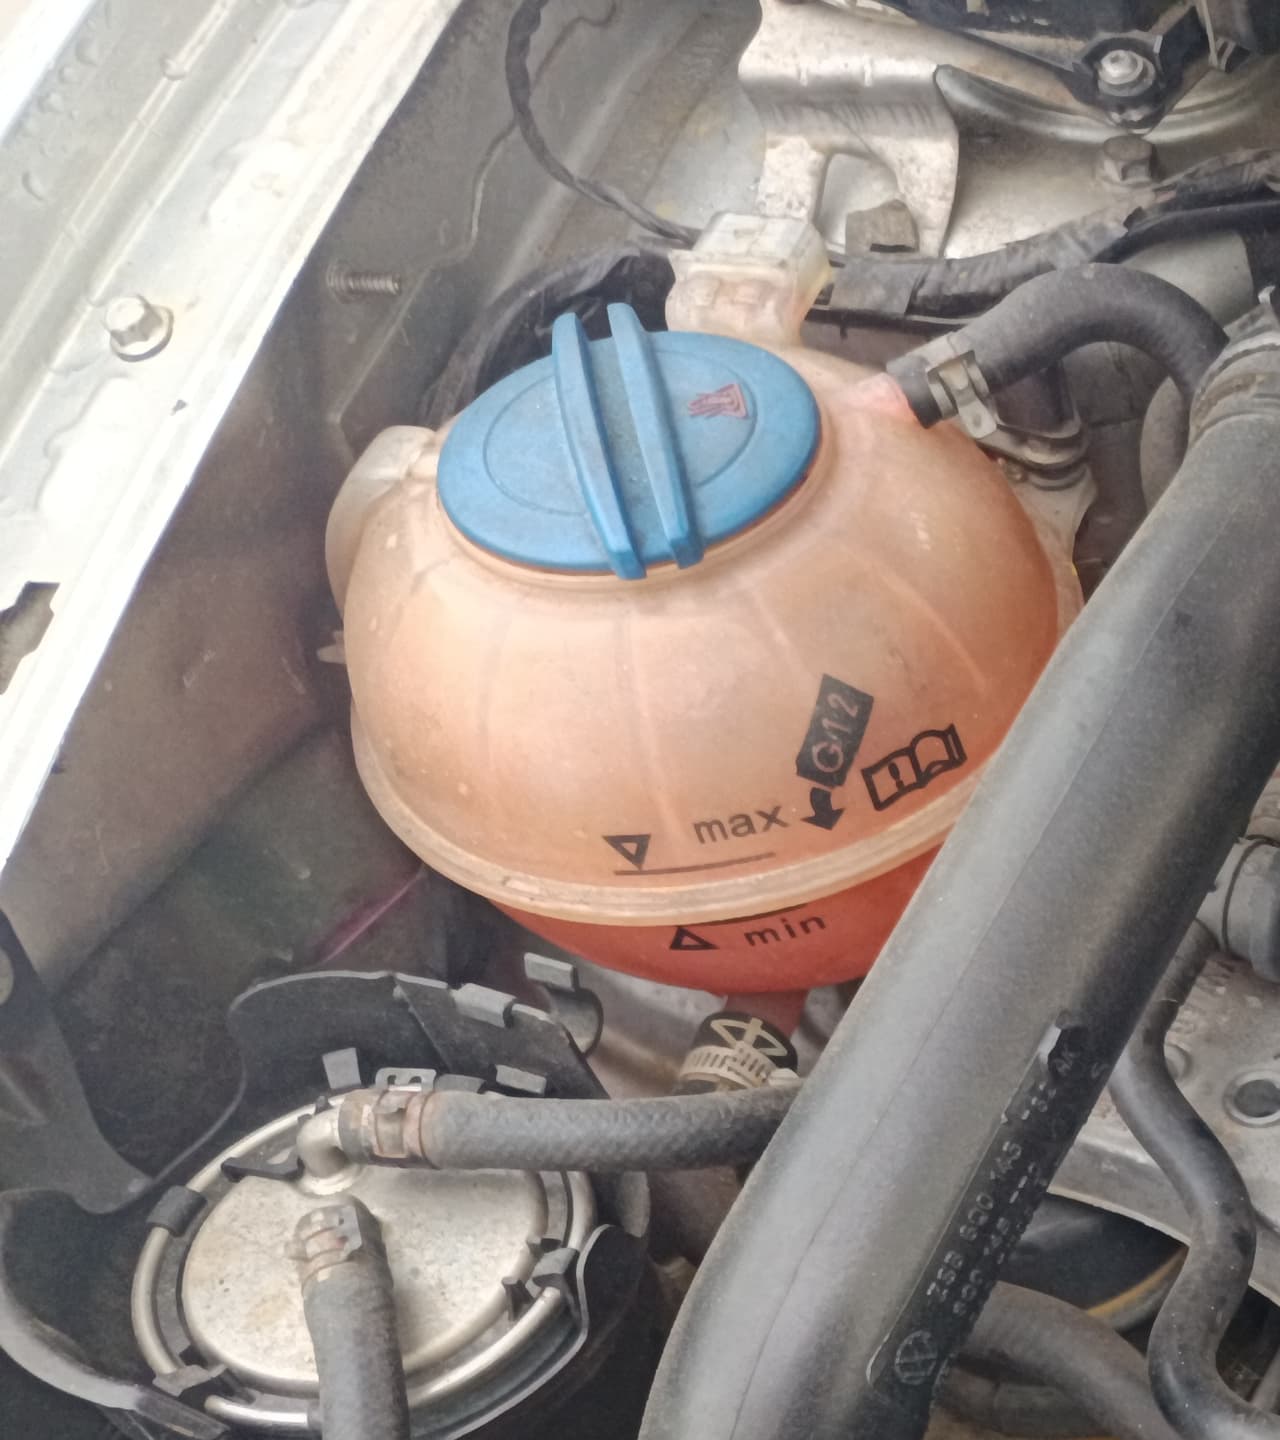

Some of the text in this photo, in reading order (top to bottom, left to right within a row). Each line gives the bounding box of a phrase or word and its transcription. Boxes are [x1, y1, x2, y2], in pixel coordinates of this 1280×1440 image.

[811, 691, 860, 774] G12
[693, 805, 790, 845] max
[743, 914, 827, 948] min
